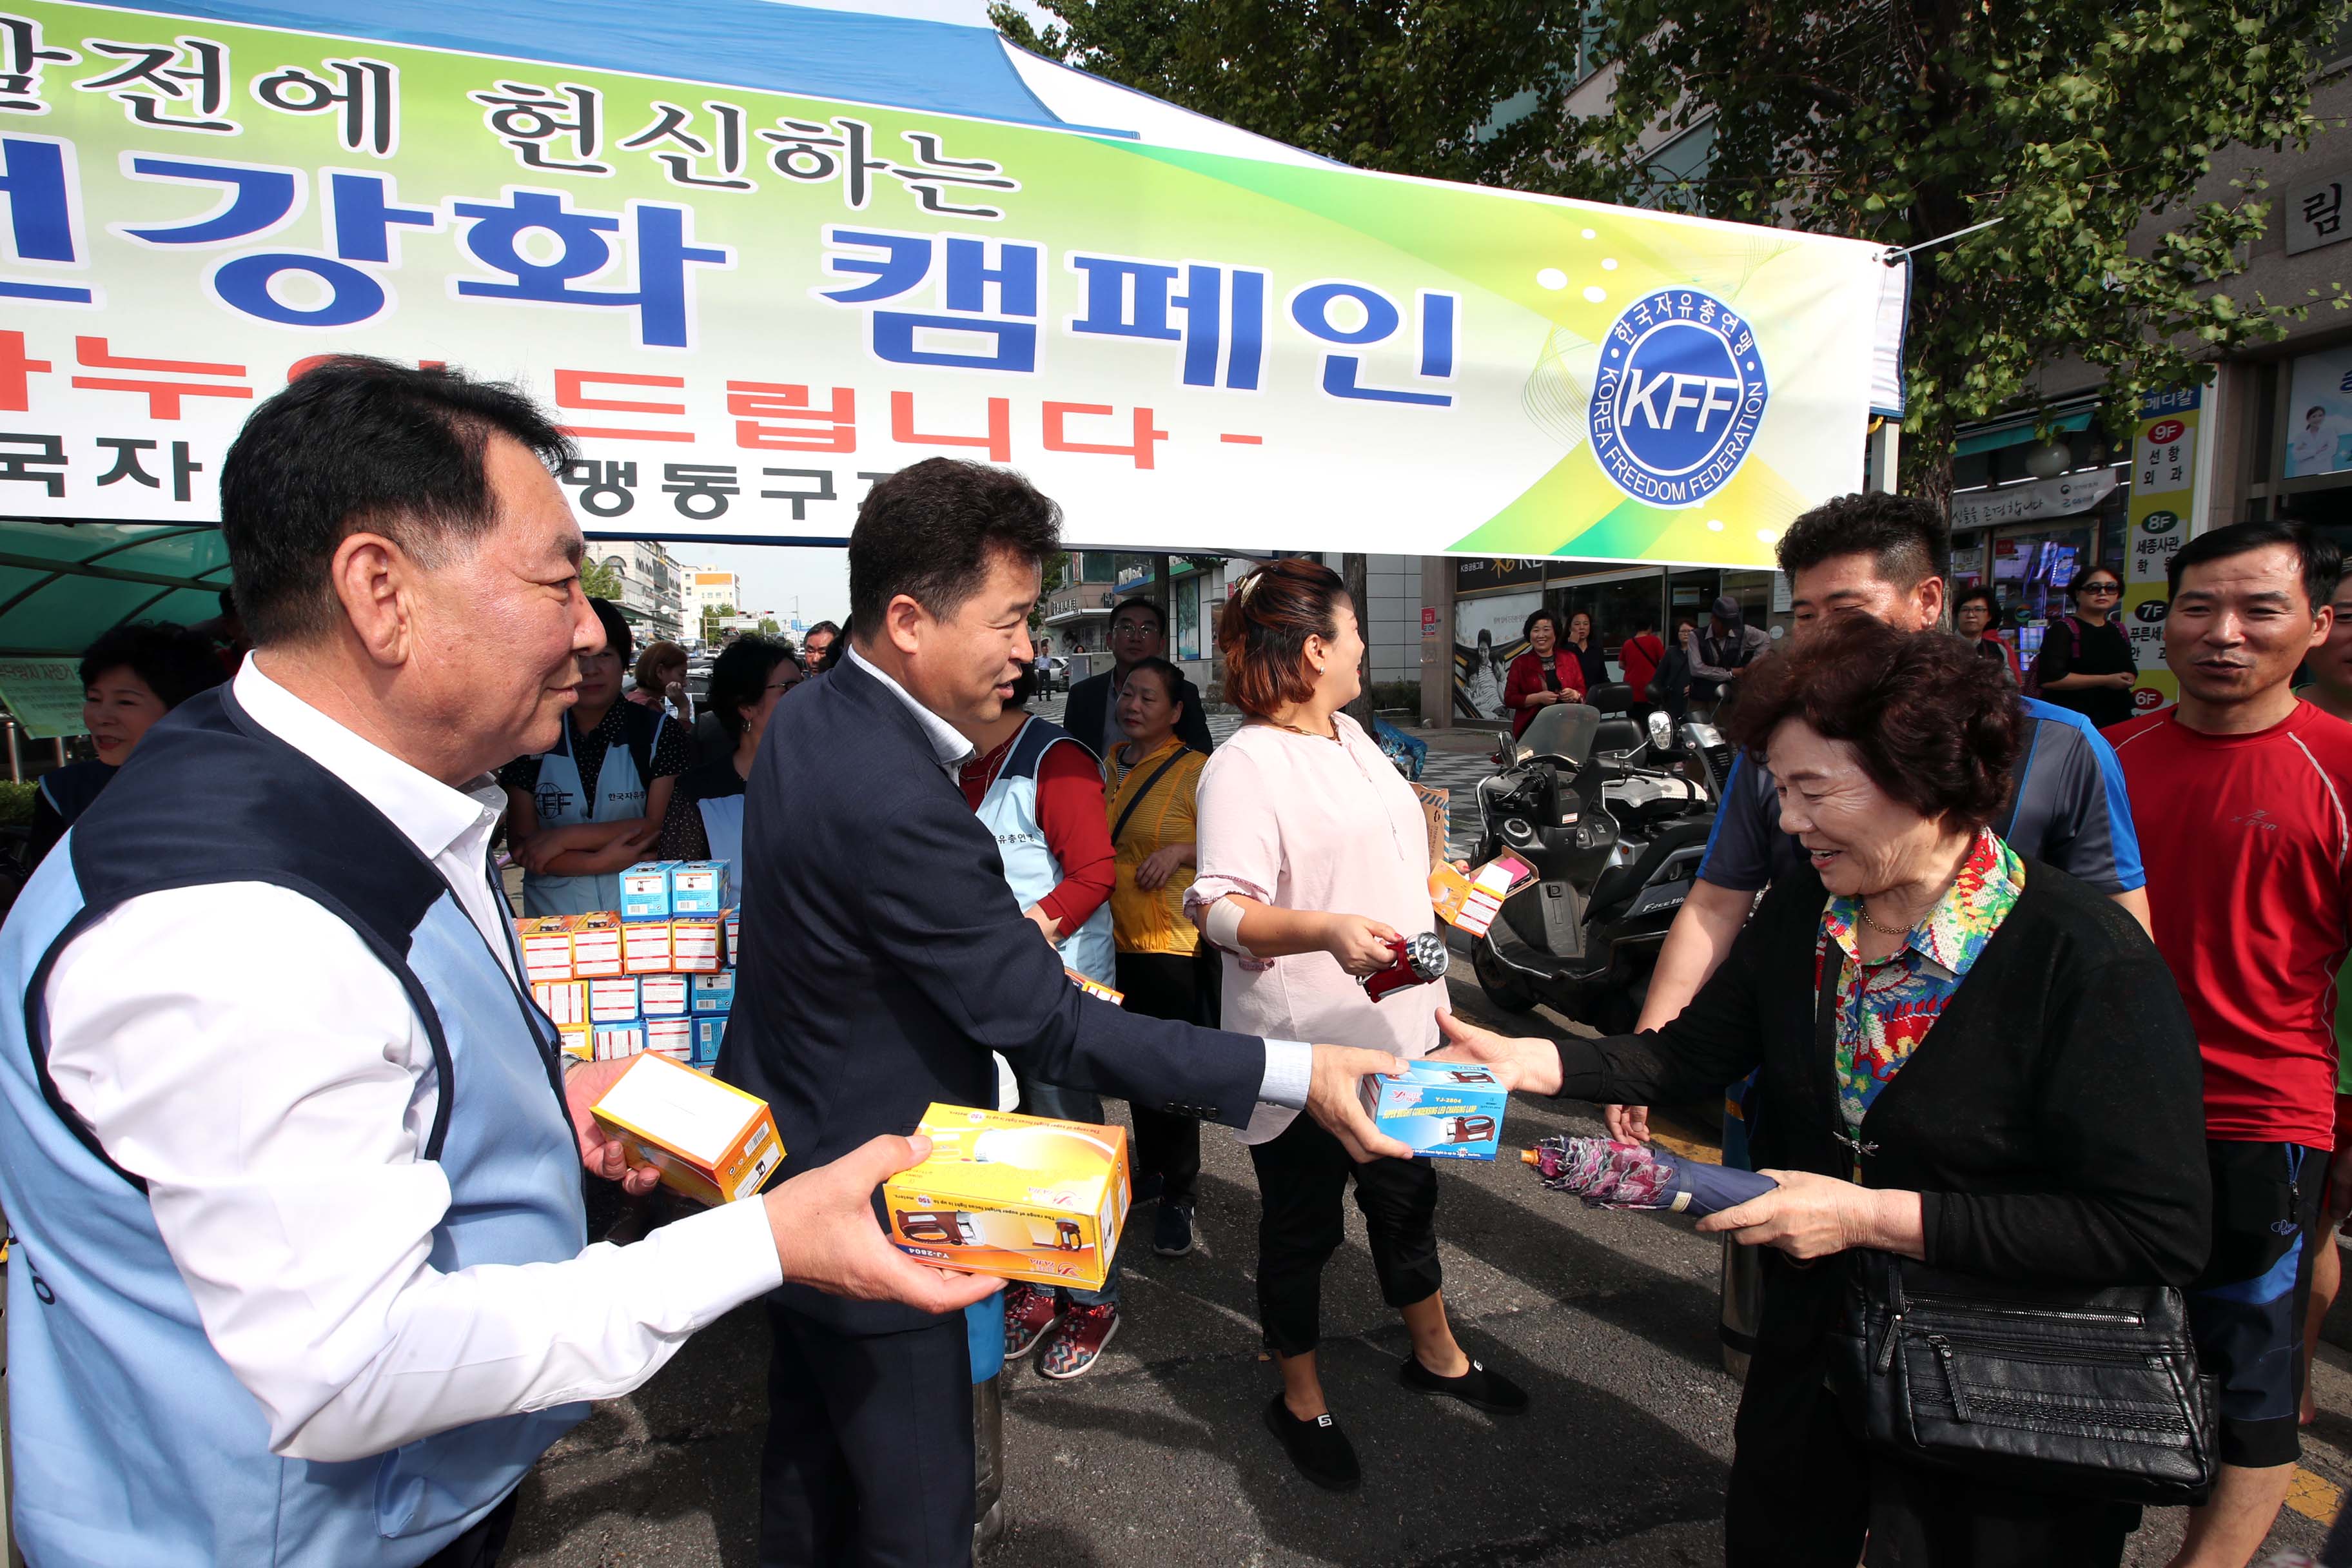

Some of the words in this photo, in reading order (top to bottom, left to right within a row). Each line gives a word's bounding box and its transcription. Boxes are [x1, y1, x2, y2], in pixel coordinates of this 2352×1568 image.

[475, 83, 1015, 217] 헌신하는
[2302, 182, 2342, 237] 림
[819, 230, 1453, 406] 캠페인
[1614, 293, 1754, 357] 한국자유총연맹
[554, 368, 1168, 470] 드립니다
[1593, 367, 1620, 449] KOREA
[1621, 368, 1740, 433] KFF
[1690, 381, 1764, 498] FEDERATION
[2155, 425, 2177, 440] 9F
[1604, 447, 1687, 502] FREEDOM
[2148, 515, 2171, 530] 8F
[2130, 626, 2164, 642] 푸른세
[2142, 604, 2164, 619] 7F
[2135, 691, 2157, 705] 6F
[908, 1247, 950, 1259] YJ-2804
